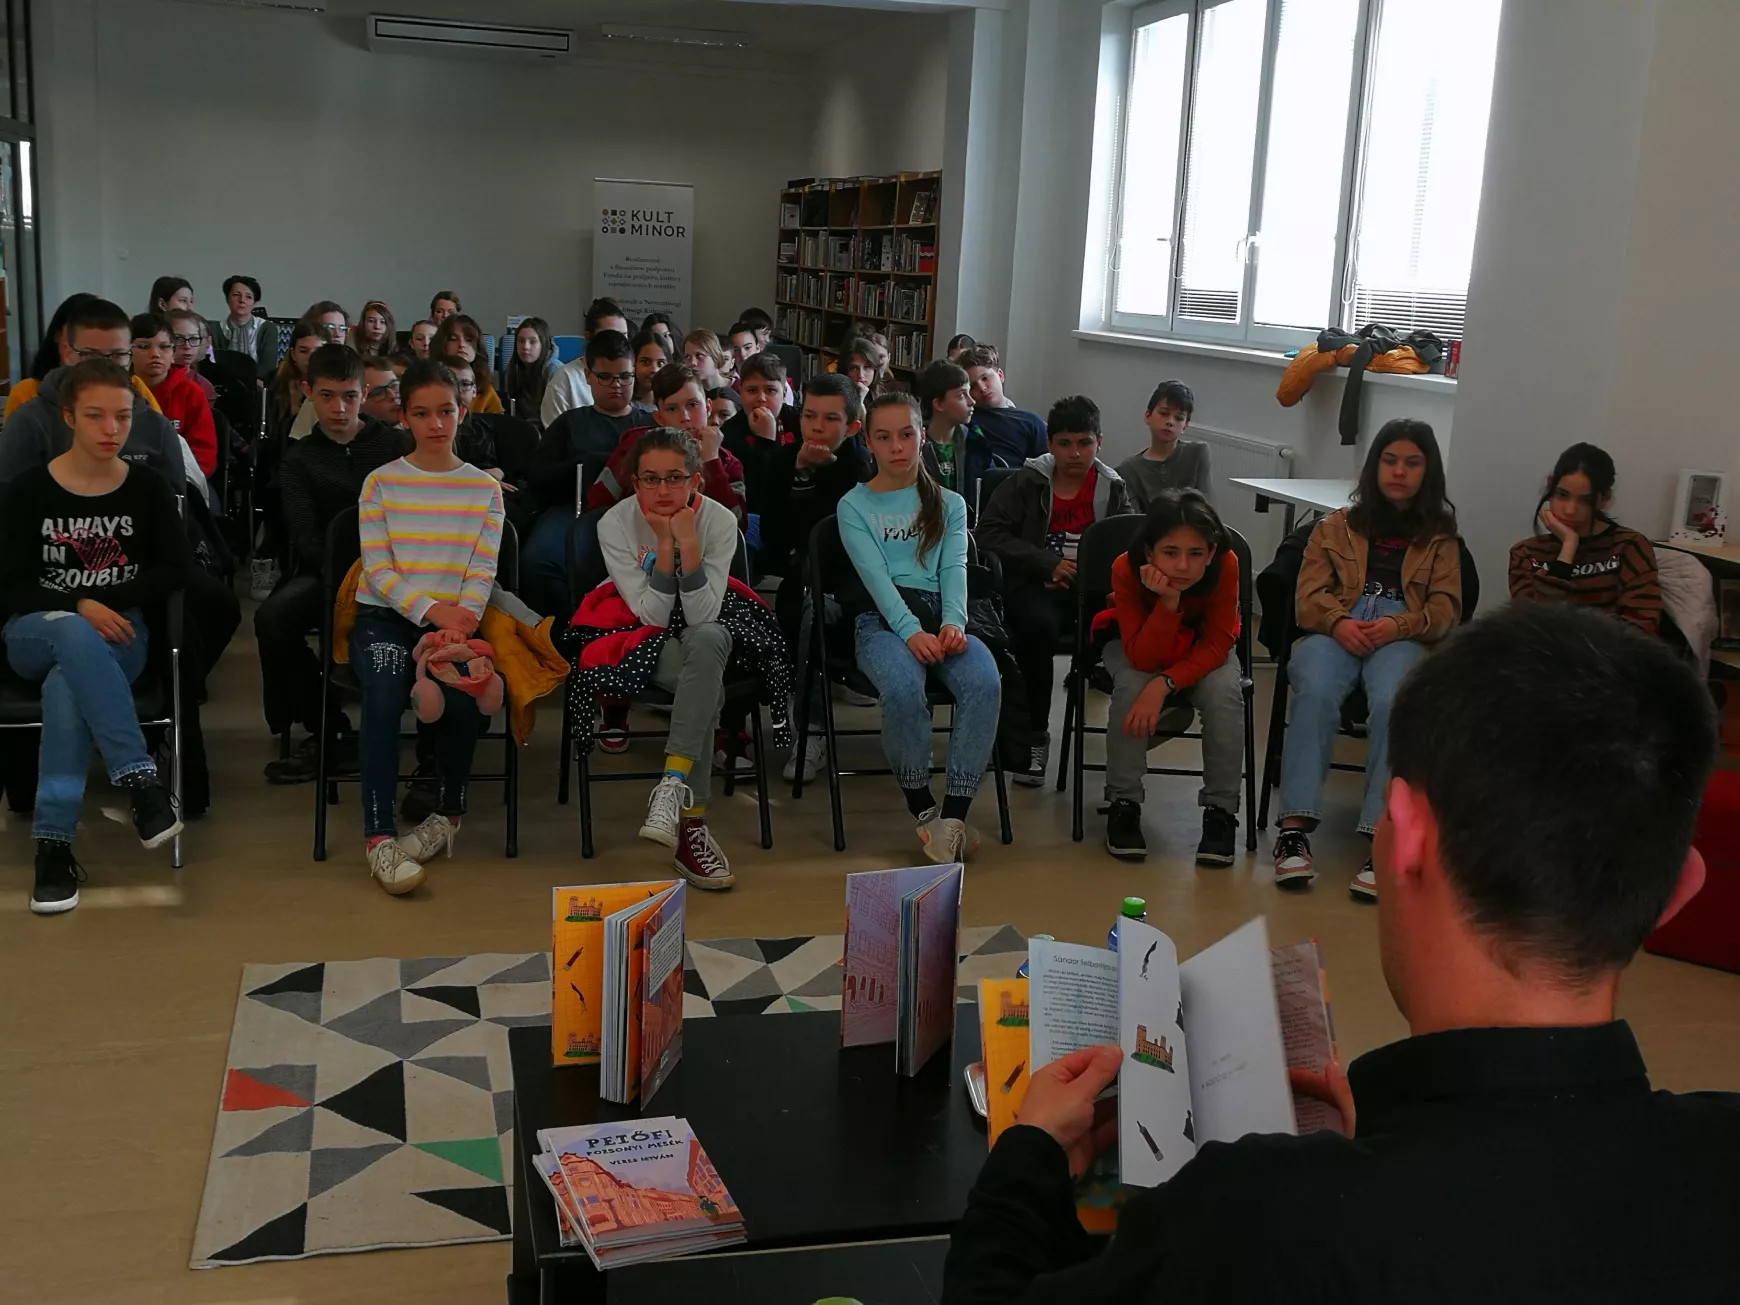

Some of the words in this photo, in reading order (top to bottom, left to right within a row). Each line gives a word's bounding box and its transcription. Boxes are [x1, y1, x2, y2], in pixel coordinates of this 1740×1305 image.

[631, 209, 674, 223] KULT
[630, 223, 686, 238] MINOR
[41, 515, 134, 540] ALWAYS
[42, 544, 66, 565] IN
[585, 1129, 673, 1149] PETŐFI
[586, 1144, 643, 1156] POZSONYI
[647, 1139, 684, 1149] MESÉK
